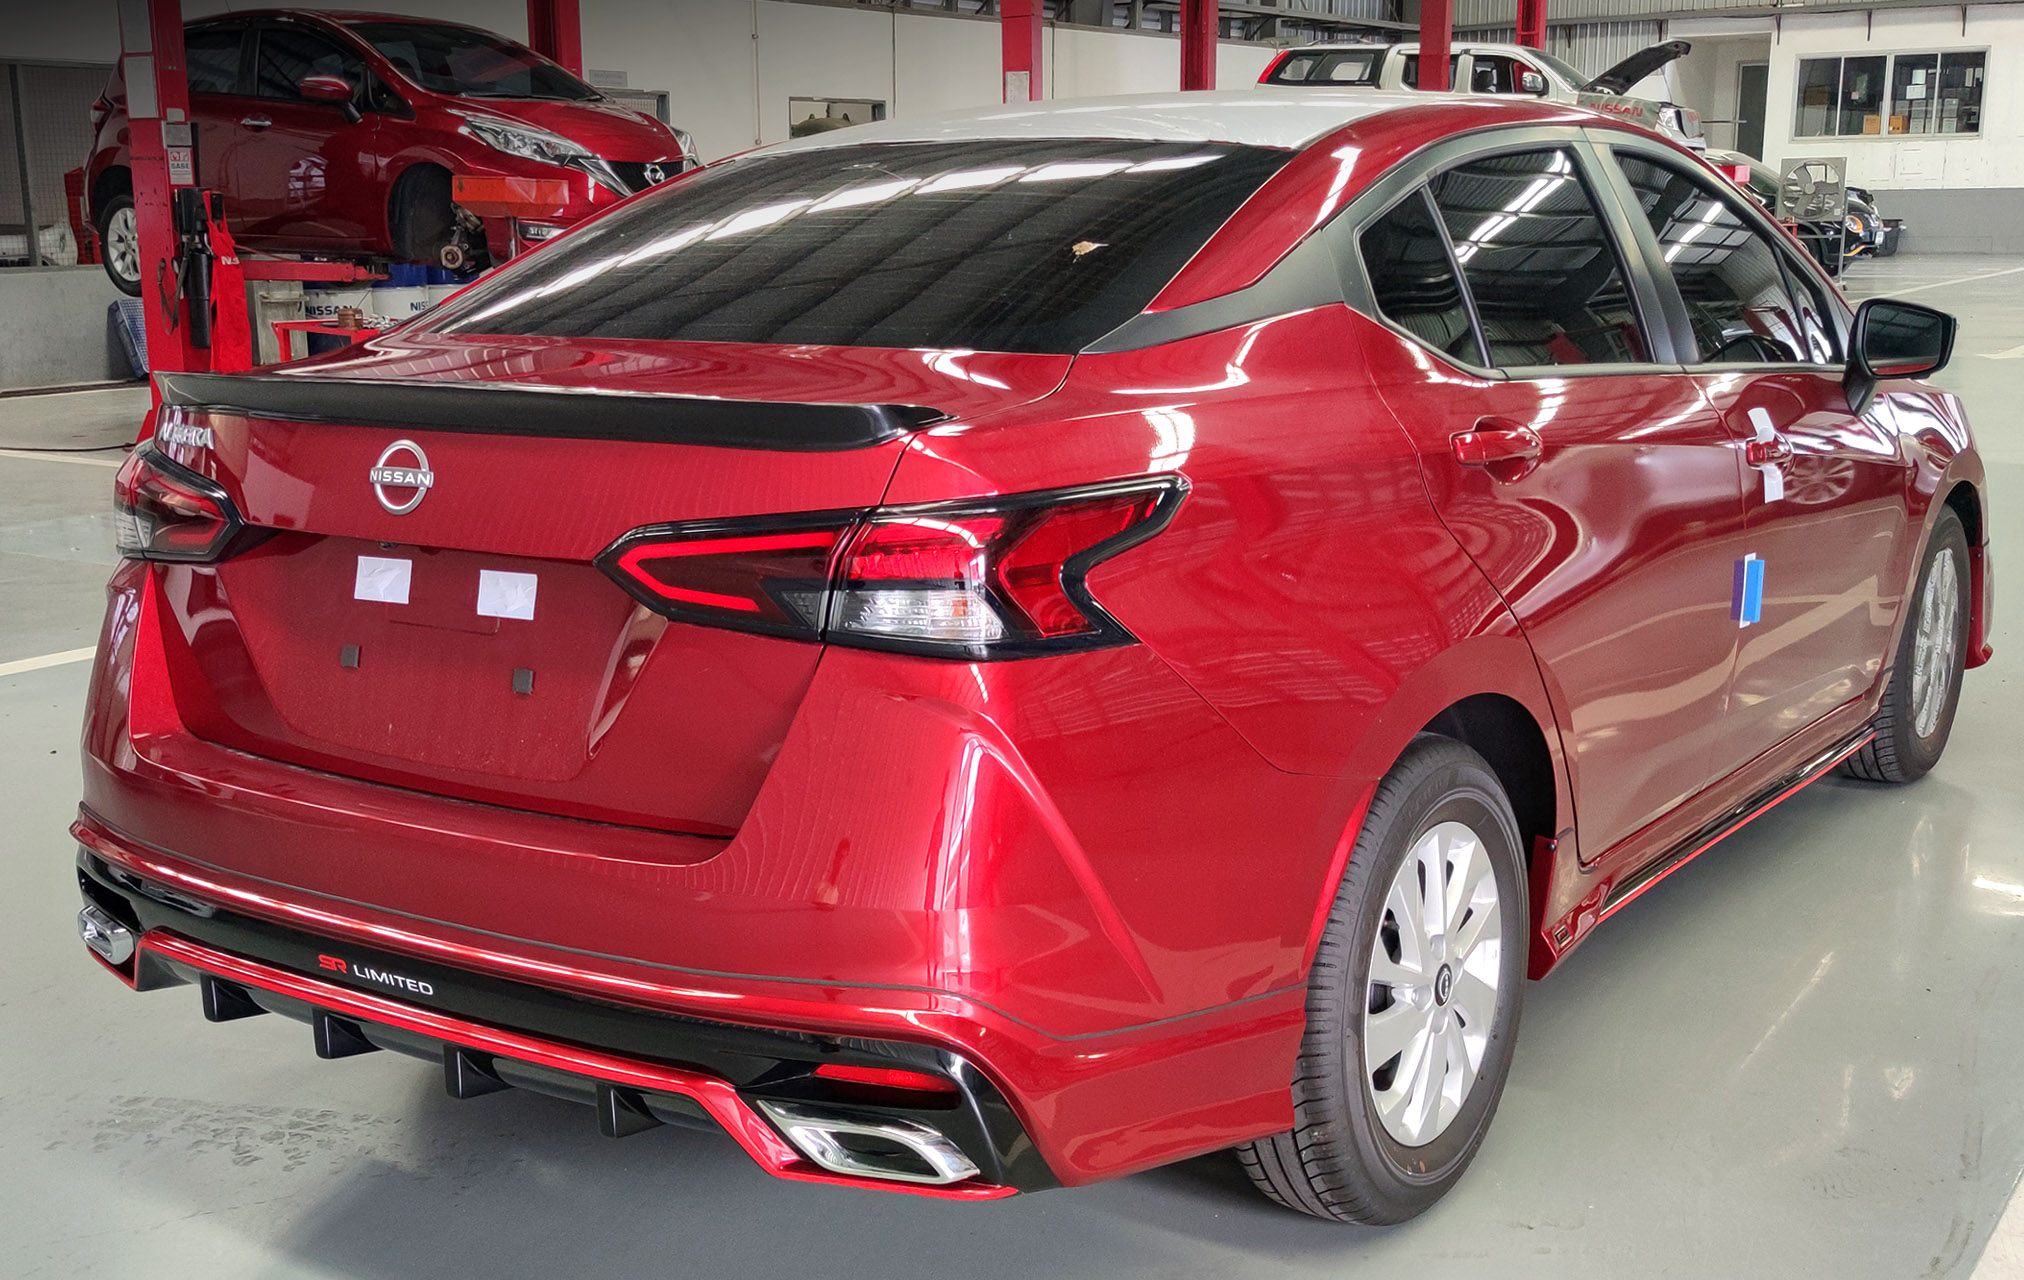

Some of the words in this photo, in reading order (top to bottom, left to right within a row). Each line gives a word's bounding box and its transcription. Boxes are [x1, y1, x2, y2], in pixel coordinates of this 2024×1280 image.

[1589, 103, 1643, 117] NISSAN
[371, 470, 431, 486] NISSAN
[318, 954, 347, 974] SR
[353, 964, 434, 996] LIMITED
